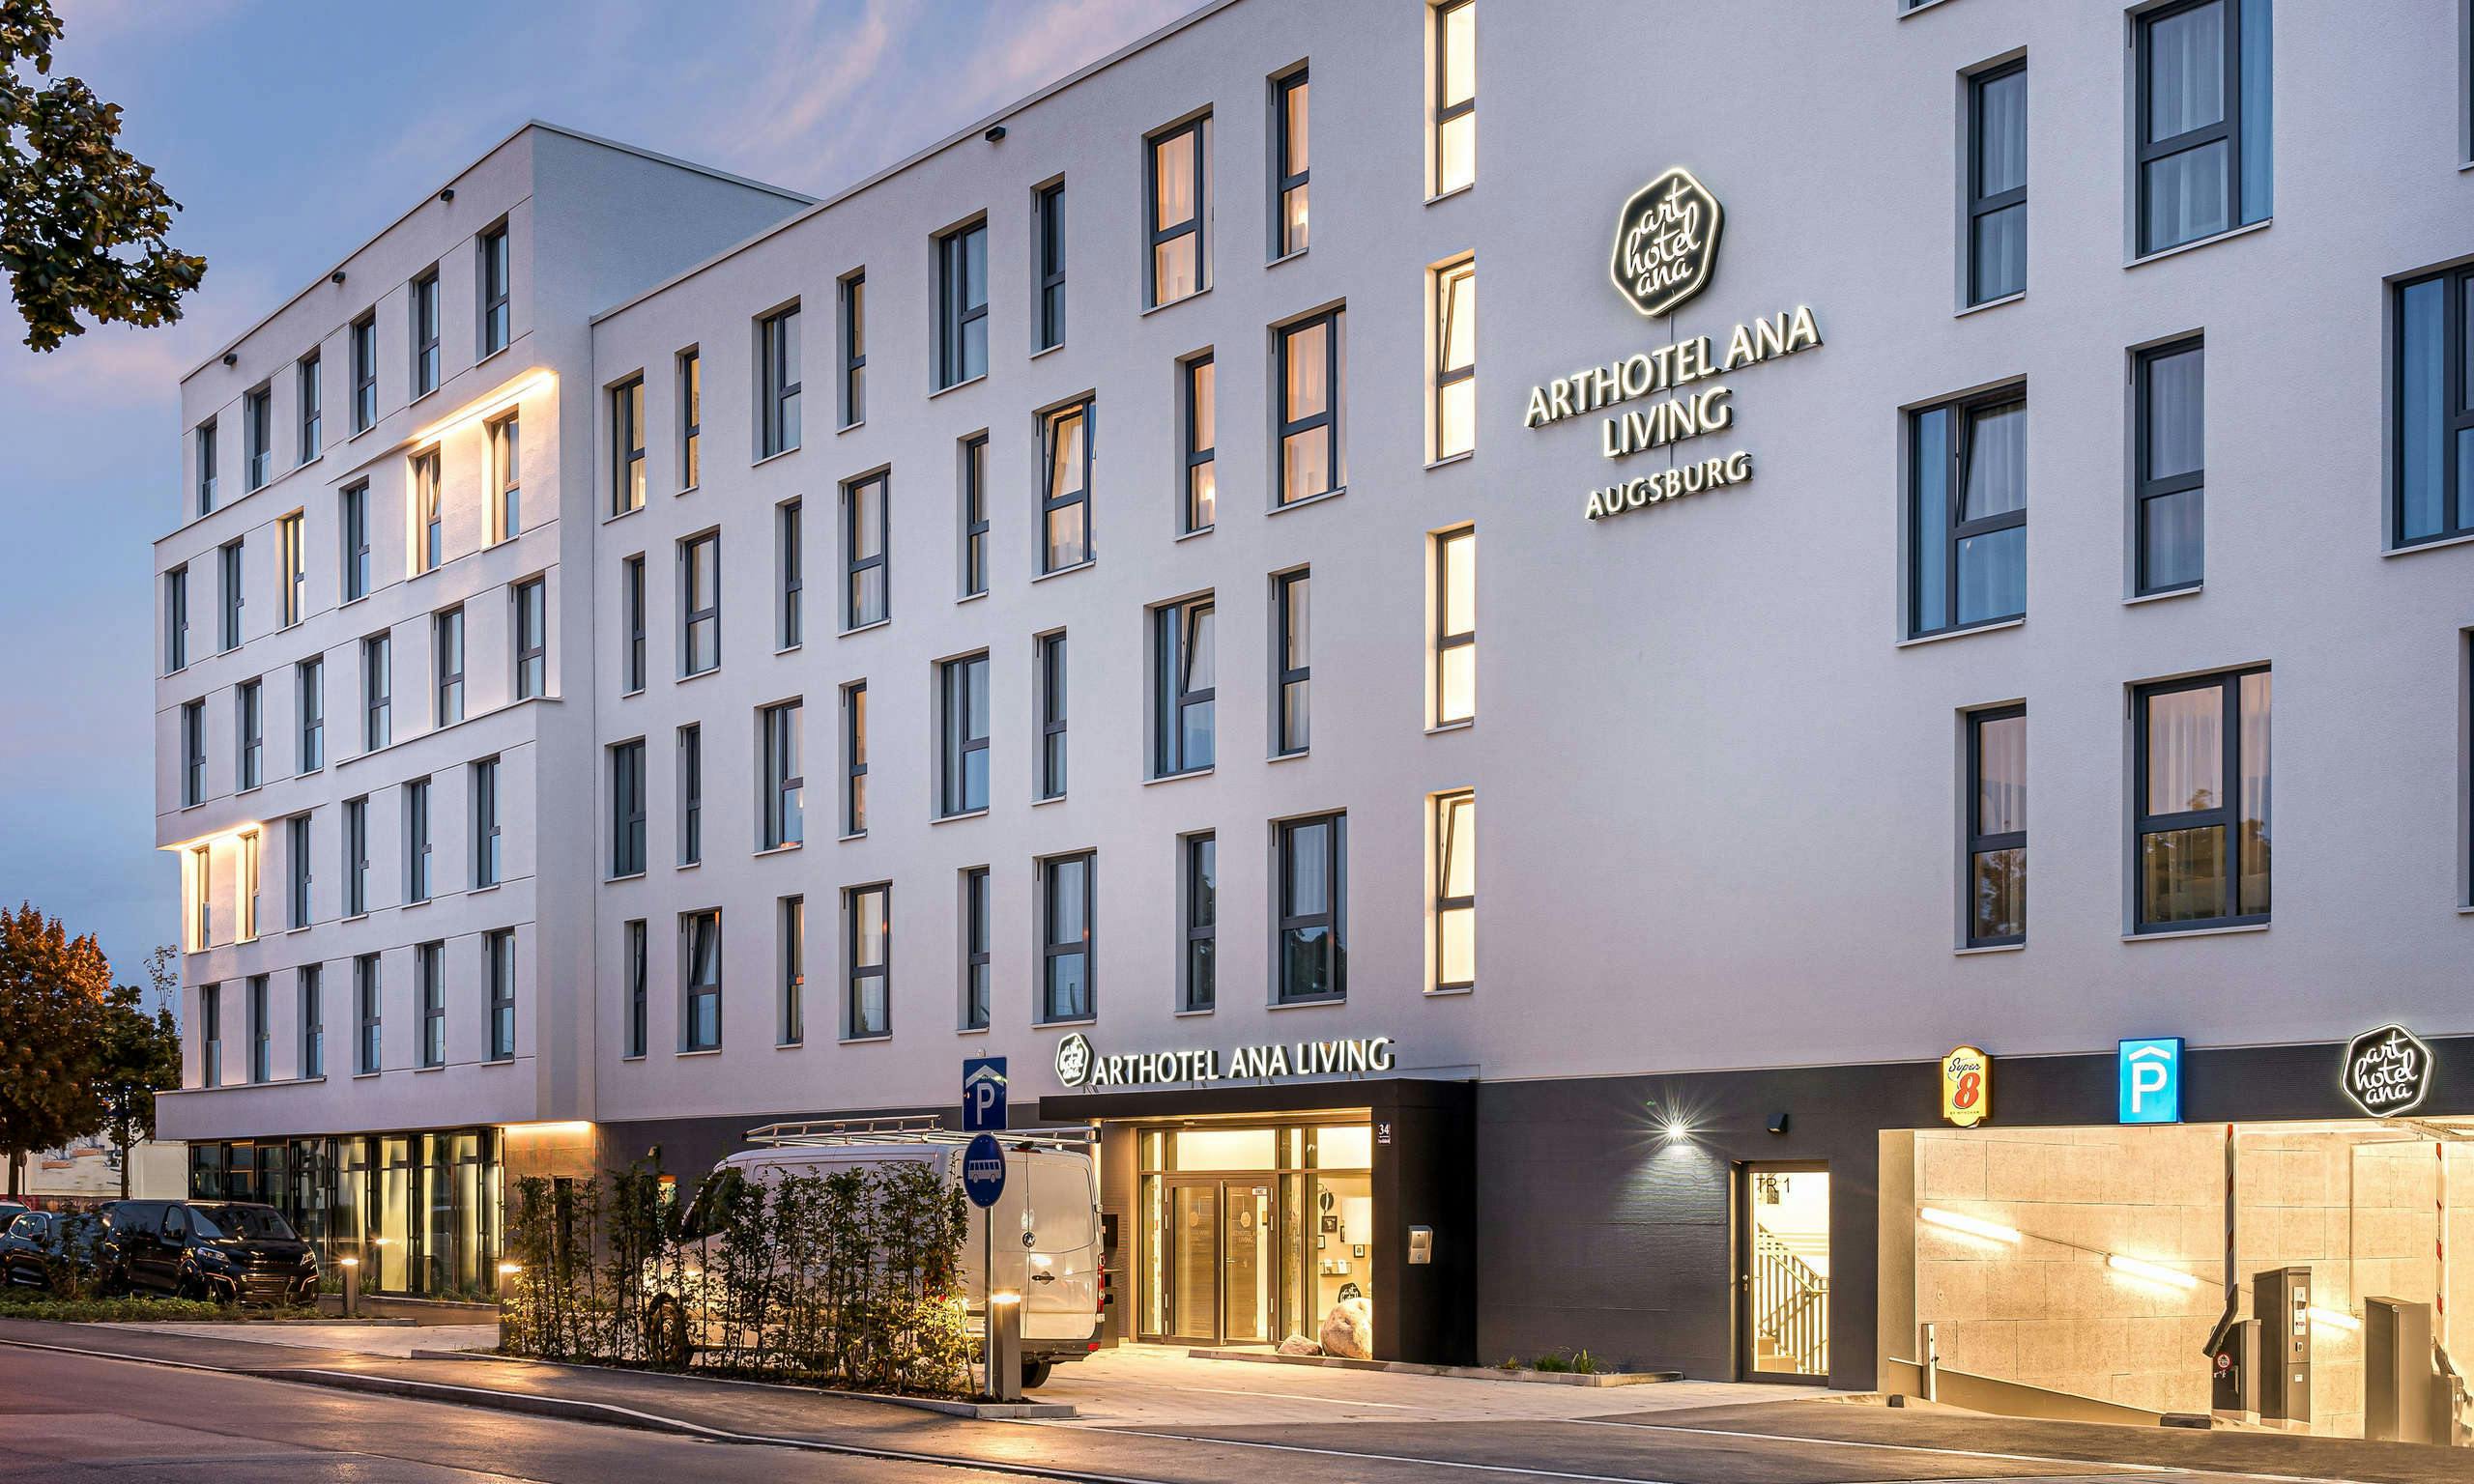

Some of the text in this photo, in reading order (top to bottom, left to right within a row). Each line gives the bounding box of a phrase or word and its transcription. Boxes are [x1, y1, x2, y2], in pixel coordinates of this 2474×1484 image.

[1639, 177, 1692, 235] art
[1625, 201, 1701, 279] hotel
[1636, 257, 1693, 297] ana
[1524, 305, 1823, 431] ARTHOTEL ANA
[1602, 386, 1733, 458] LIVING
[1584, 450, 1752, 521] AUGSBURG
[1092, 1037, 1392, 1085] ARTHOTEL ANA LIVING
[1948, 1057, 1981, 1079] Super
[2366, 1030, 2408, 1063] art
[1953, 1072, 1980, 1109] 8
[2132, 1062, 2168, 1113] P
[2355, 1048, 2418, 1091] hotel
[977, 1082, 994, 1125] P
[2365, 1083, 2413, 1104] ana
[1378, 1124, 1390, 1135] 34
[1755, 1177, 1790, 1193] TR 1
